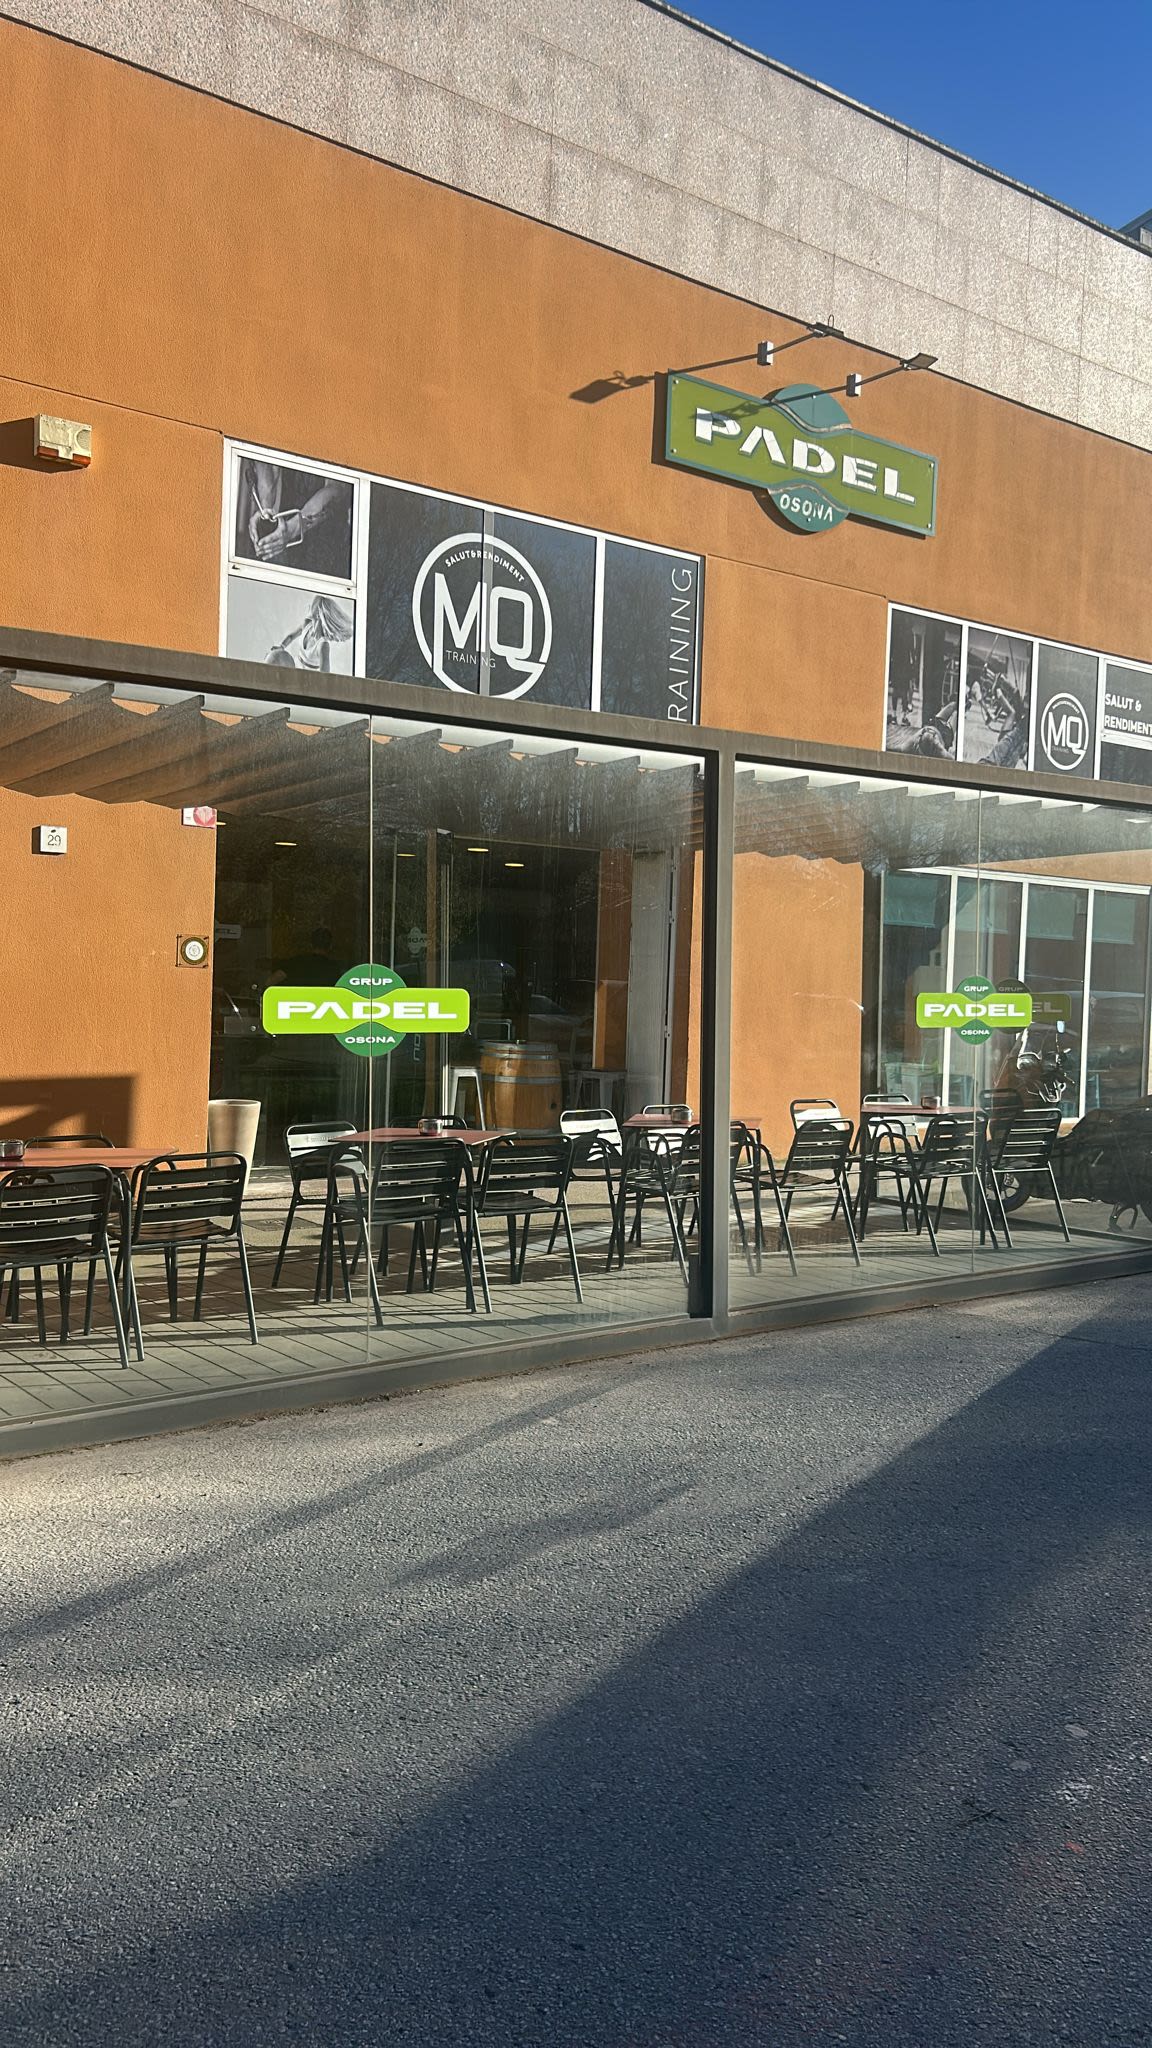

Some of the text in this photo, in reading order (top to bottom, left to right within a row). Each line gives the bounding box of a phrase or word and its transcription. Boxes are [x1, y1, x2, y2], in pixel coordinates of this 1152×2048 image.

[695, 407, 916, 505] PADEL
[780, 493, 833, 522] OSONA
[433, 572, 546, 674] MQ
[667, 568, 692, 722] RAINING
[446, 649, 497, 668] TRAINNG
[1105, 693, 1142, 712] SALUT &
[1047, 711, 1086, 756] MQ
[47, 834, 62, 847] 29
[349, 977, 393, 986] GRUP
[277, 1001, 458, 1020] PADEL
[924, 1003, 1025, 1017] PADEL
[345, 1036, 396, 1044] OSONA
